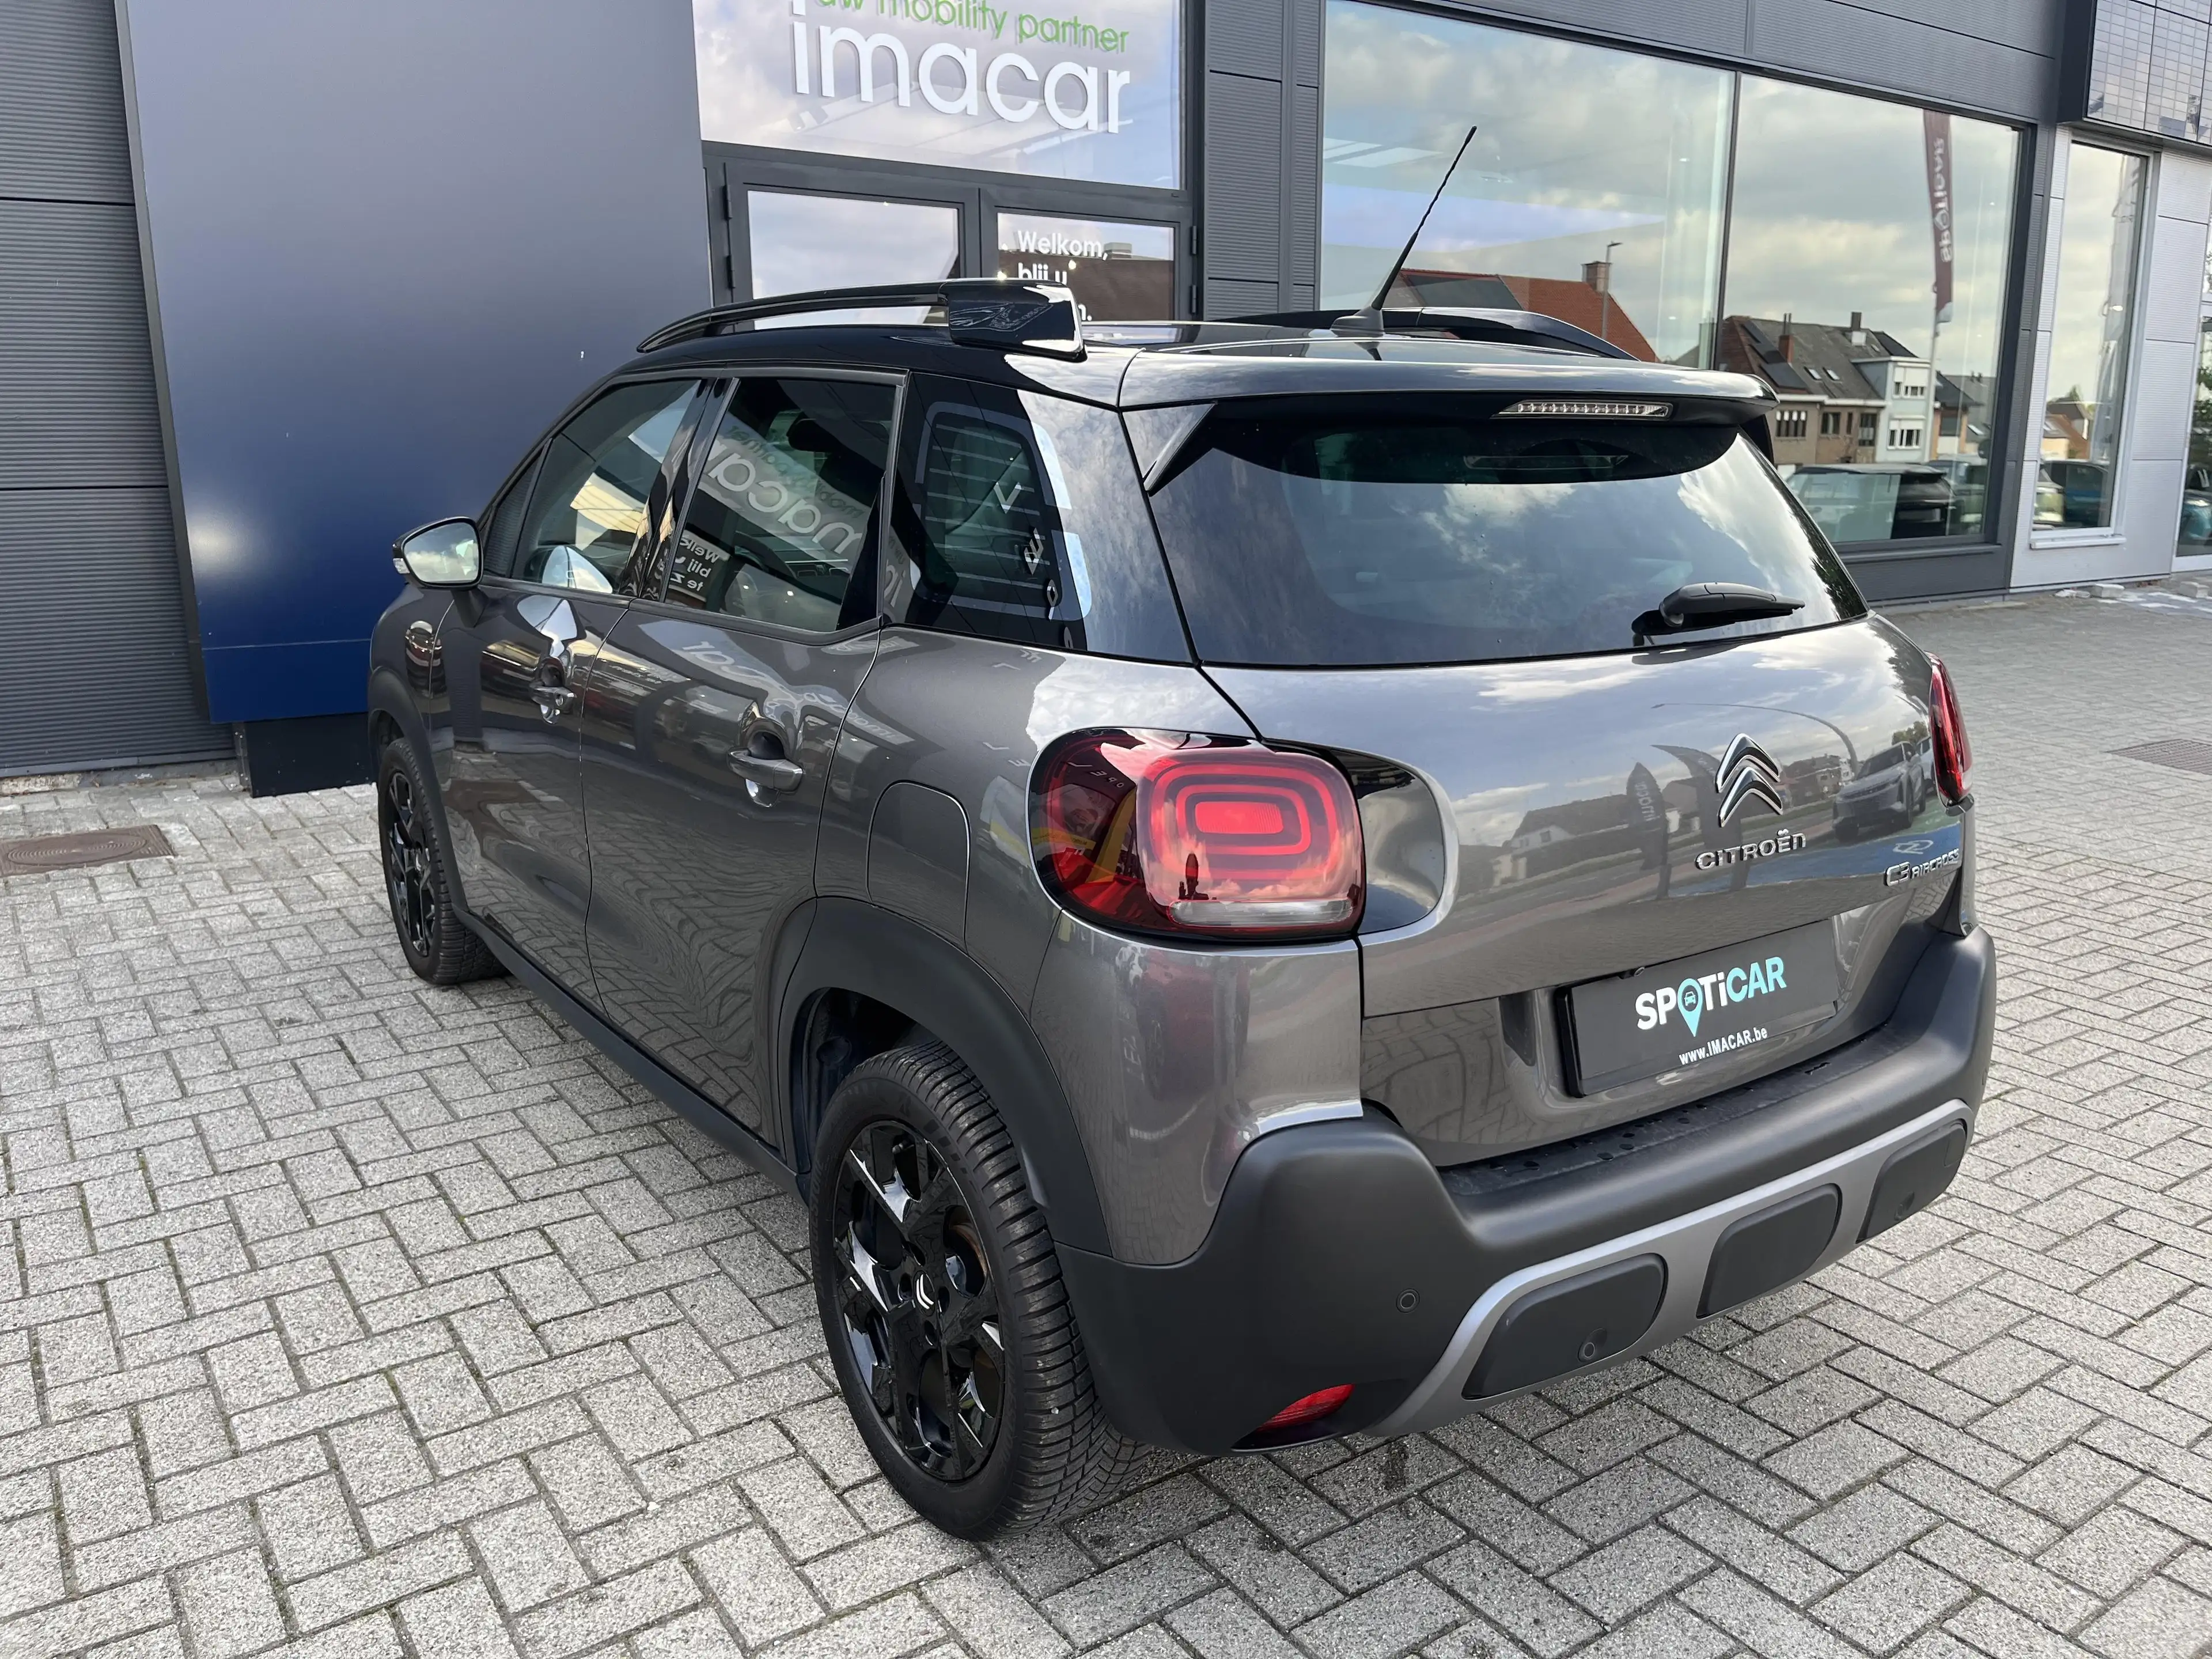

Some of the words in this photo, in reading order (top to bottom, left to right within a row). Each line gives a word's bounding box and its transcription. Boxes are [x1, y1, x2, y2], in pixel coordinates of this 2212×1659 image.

[1019, 14, 1130, 54] partner
[792, 0, 1130, 134] imacar
[1016, 230, 1109, 261] Welkom,
[1885, 861, 1911, 887] C3
[1911, 847, 1961, 880] AIRCROSS
[1678, 1027, 1768, 1066] www.IMACAR.be
